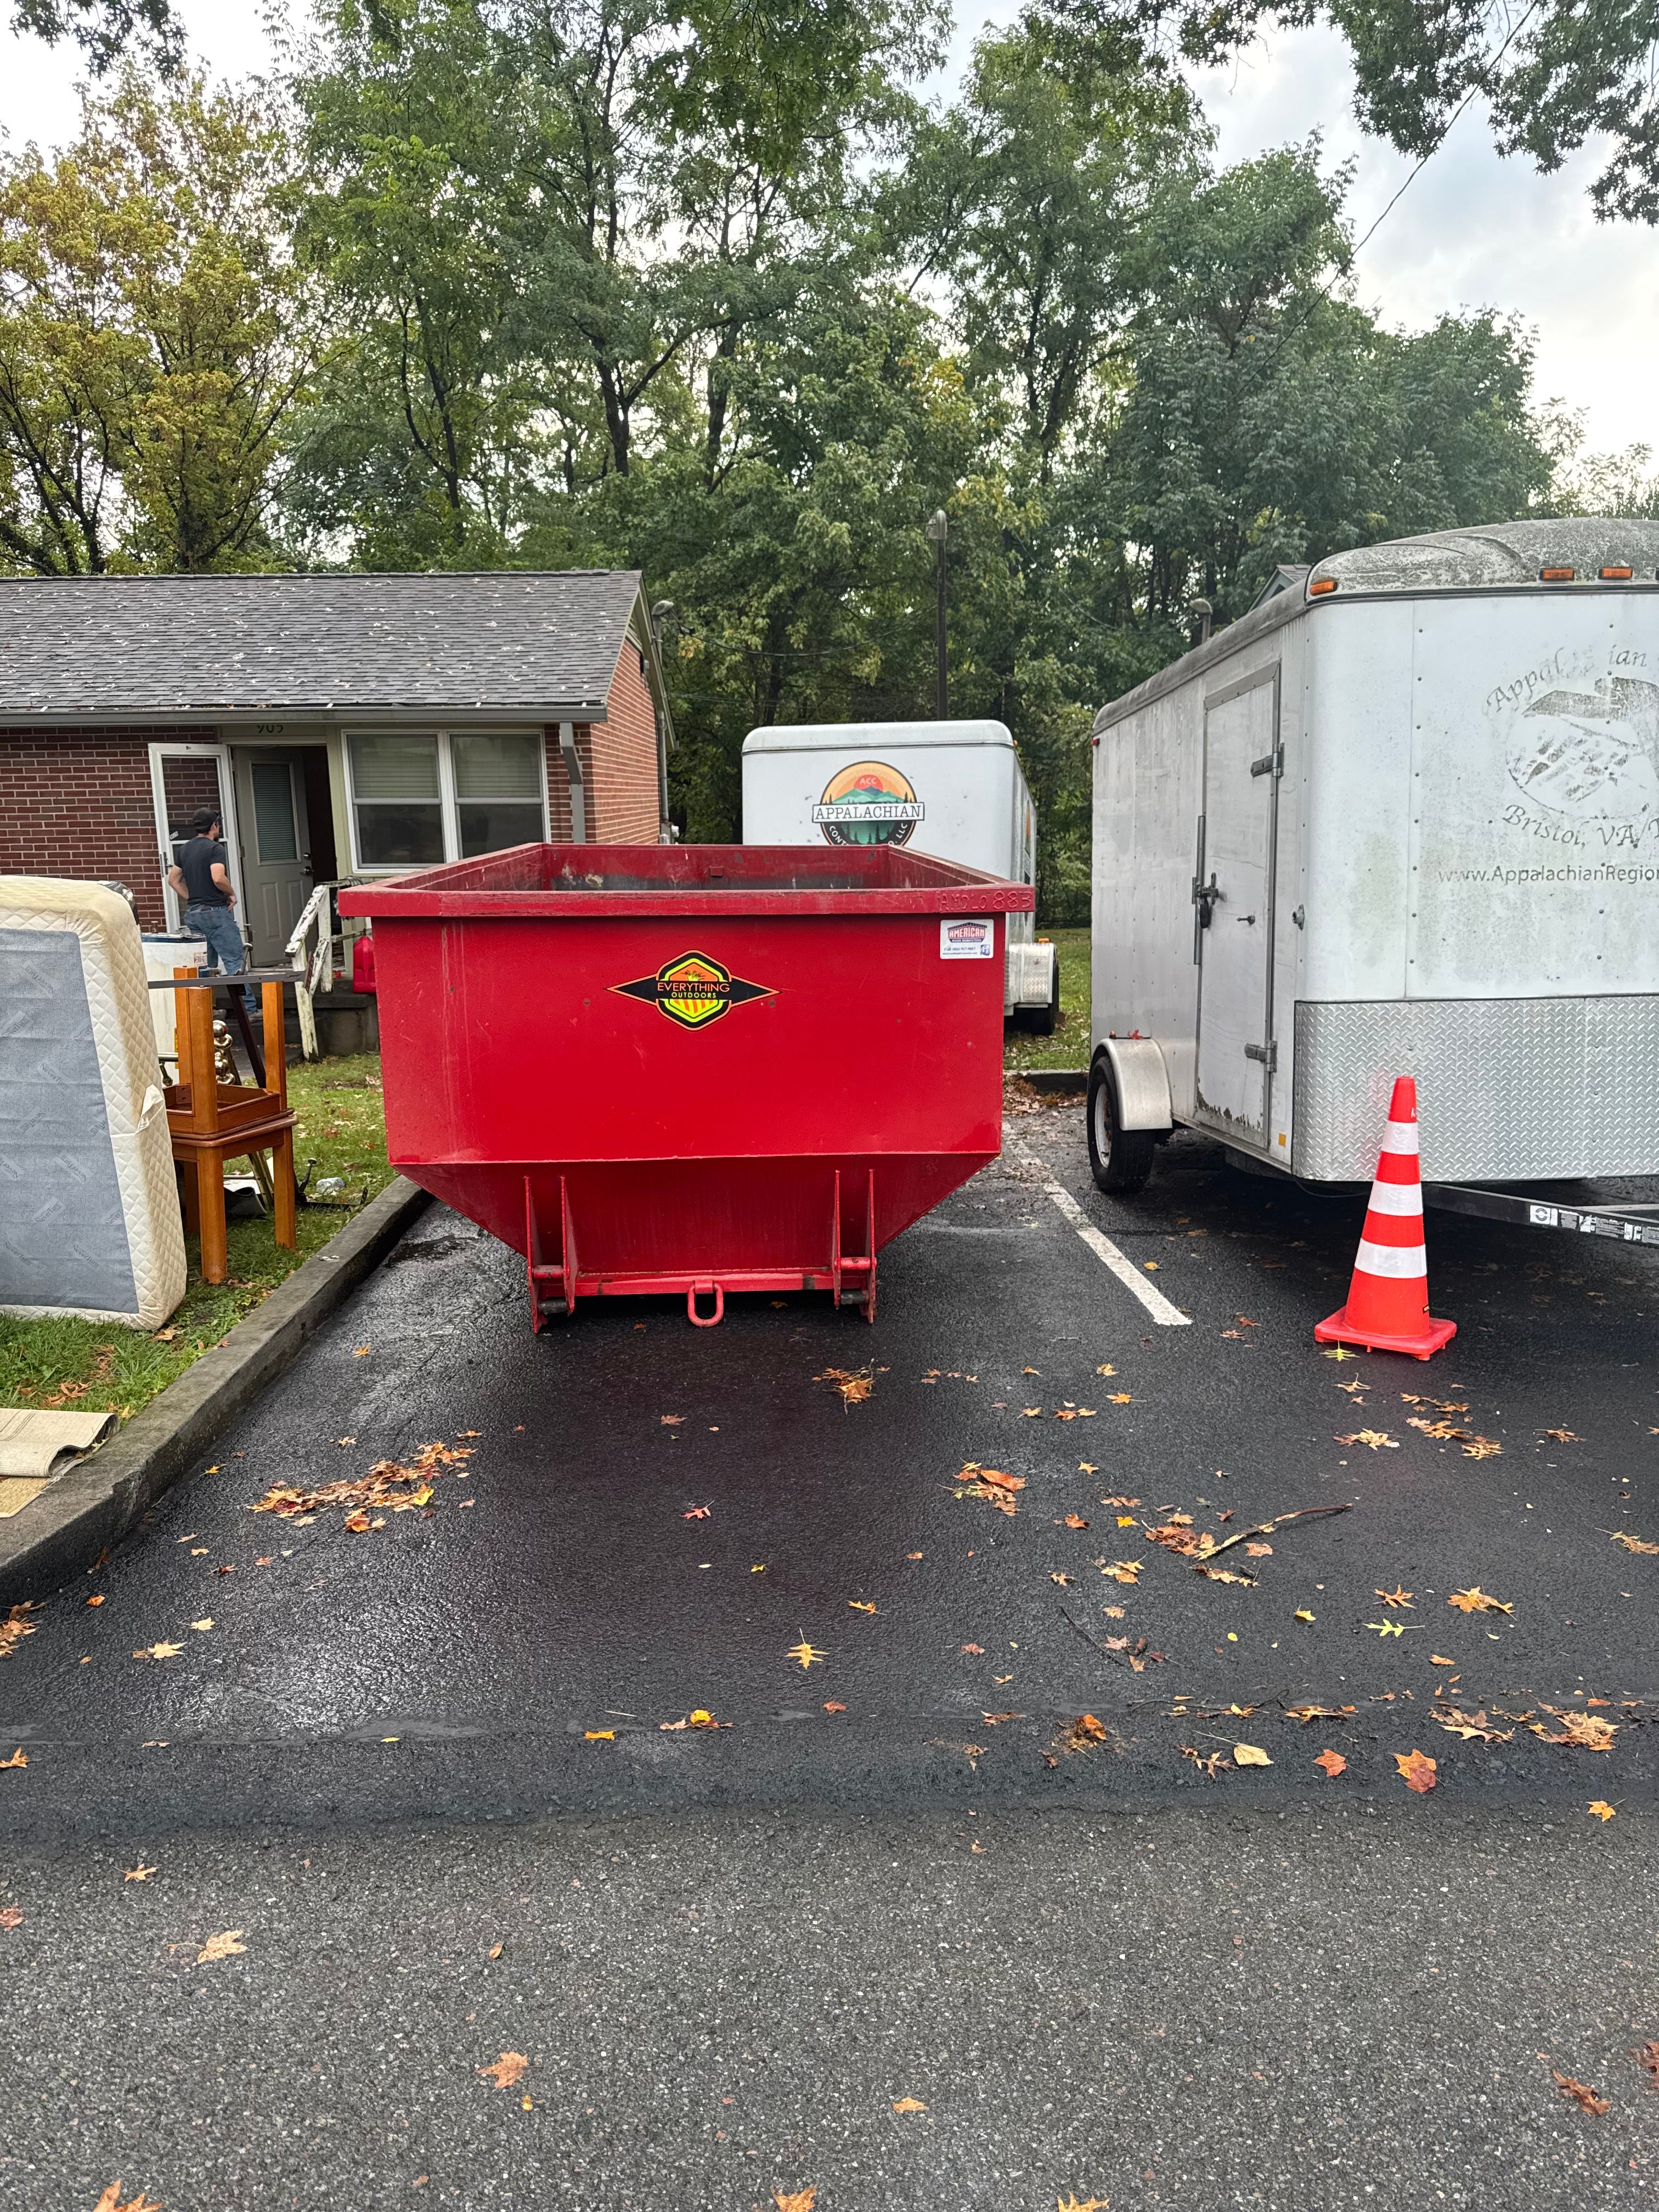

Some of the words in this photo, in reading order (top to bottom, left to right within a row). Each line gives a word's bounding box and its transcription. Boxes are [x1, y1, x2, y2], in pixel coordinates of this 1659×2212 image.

[1482, 644, 1647, 715] Appalian
[859, 777, 877, 785] ACC
[815, 805, 921, 820] APPALACHIAN
[829, 825, 849, 845] CONT
[896, 823, 907, 838] LLC
[992, 890, 1032, 910] 883
[949, 927, 985, 938] AMERICAN
[25, 967, 56, 994] NeverTurn
[658, 983, 730, 992] EVERYTHING
[41, 1063, 69, 1091] NeverTurn
[61, 1154, 89, 1181] NeverTurn
